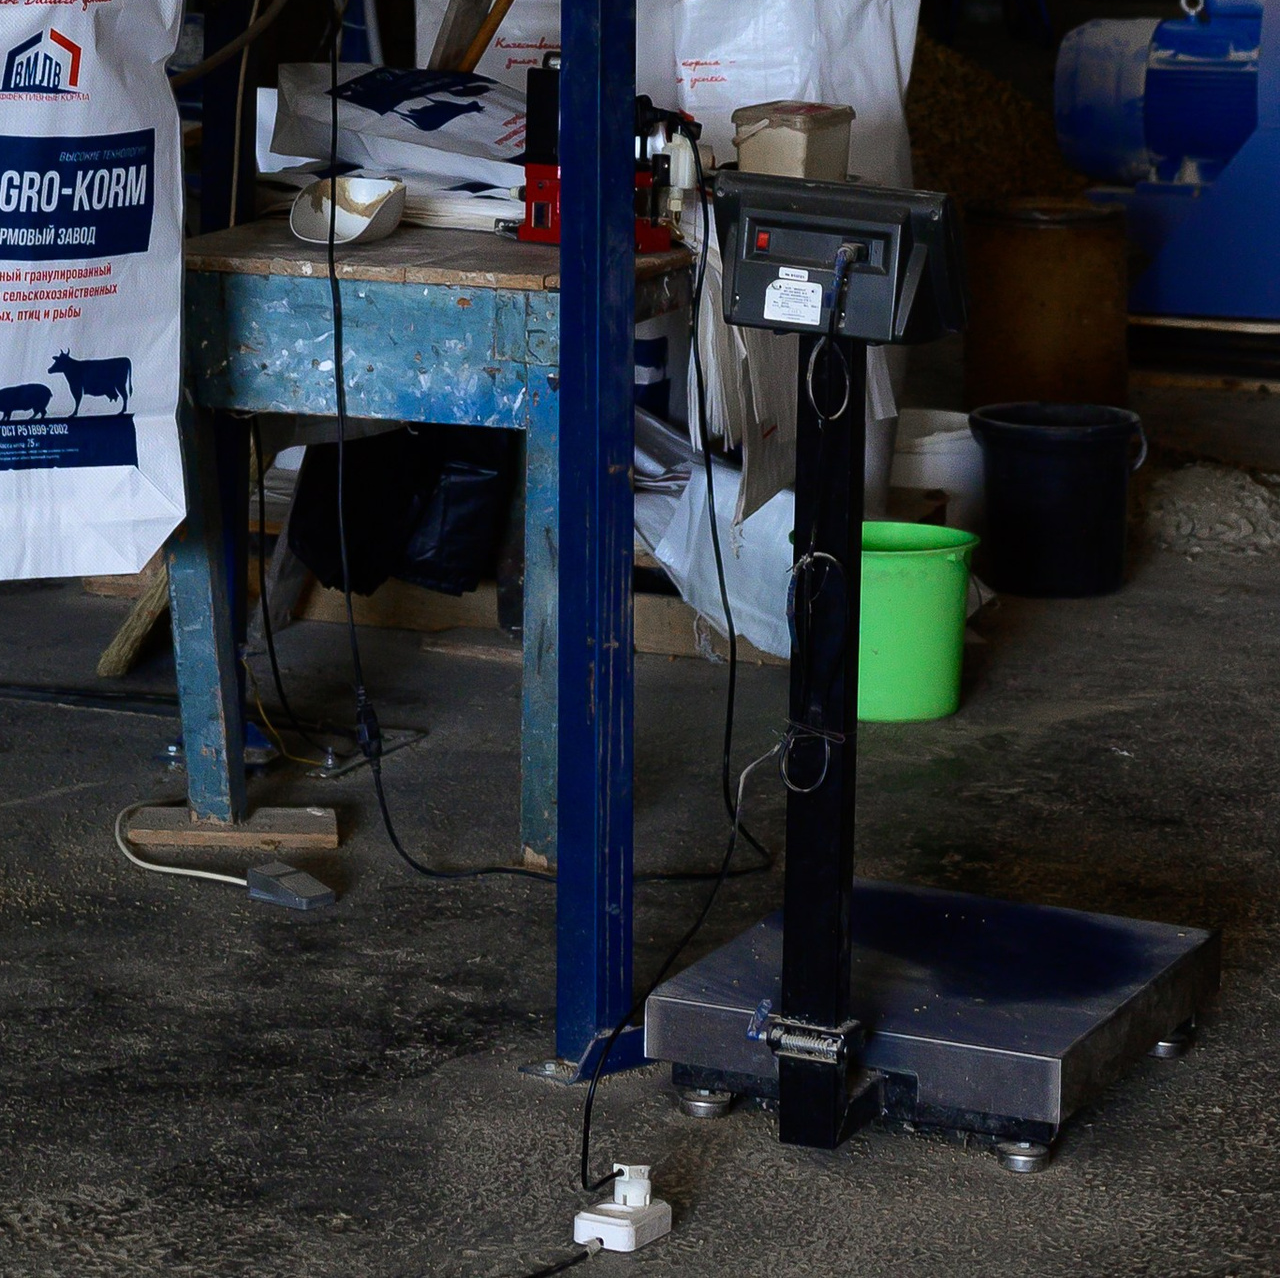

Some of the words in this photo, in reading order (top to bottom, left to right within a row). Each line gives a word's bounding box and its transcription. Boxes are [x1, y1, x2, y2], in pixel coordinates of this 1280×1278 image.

[60, 93, 90, 101] КОРМА
[58, 150, 102, 162] ВЫСОКИЕ
[57, 225, 97, 246] ЗАВОД
[24, 262, 112, 284] гранулированный
[3, 283, 118, 303] сельскохозяйственных
[17, 308, 41, 323] птиц
[43, 309, 51, 319] и
[53, 306, 82, 322] рыбы
